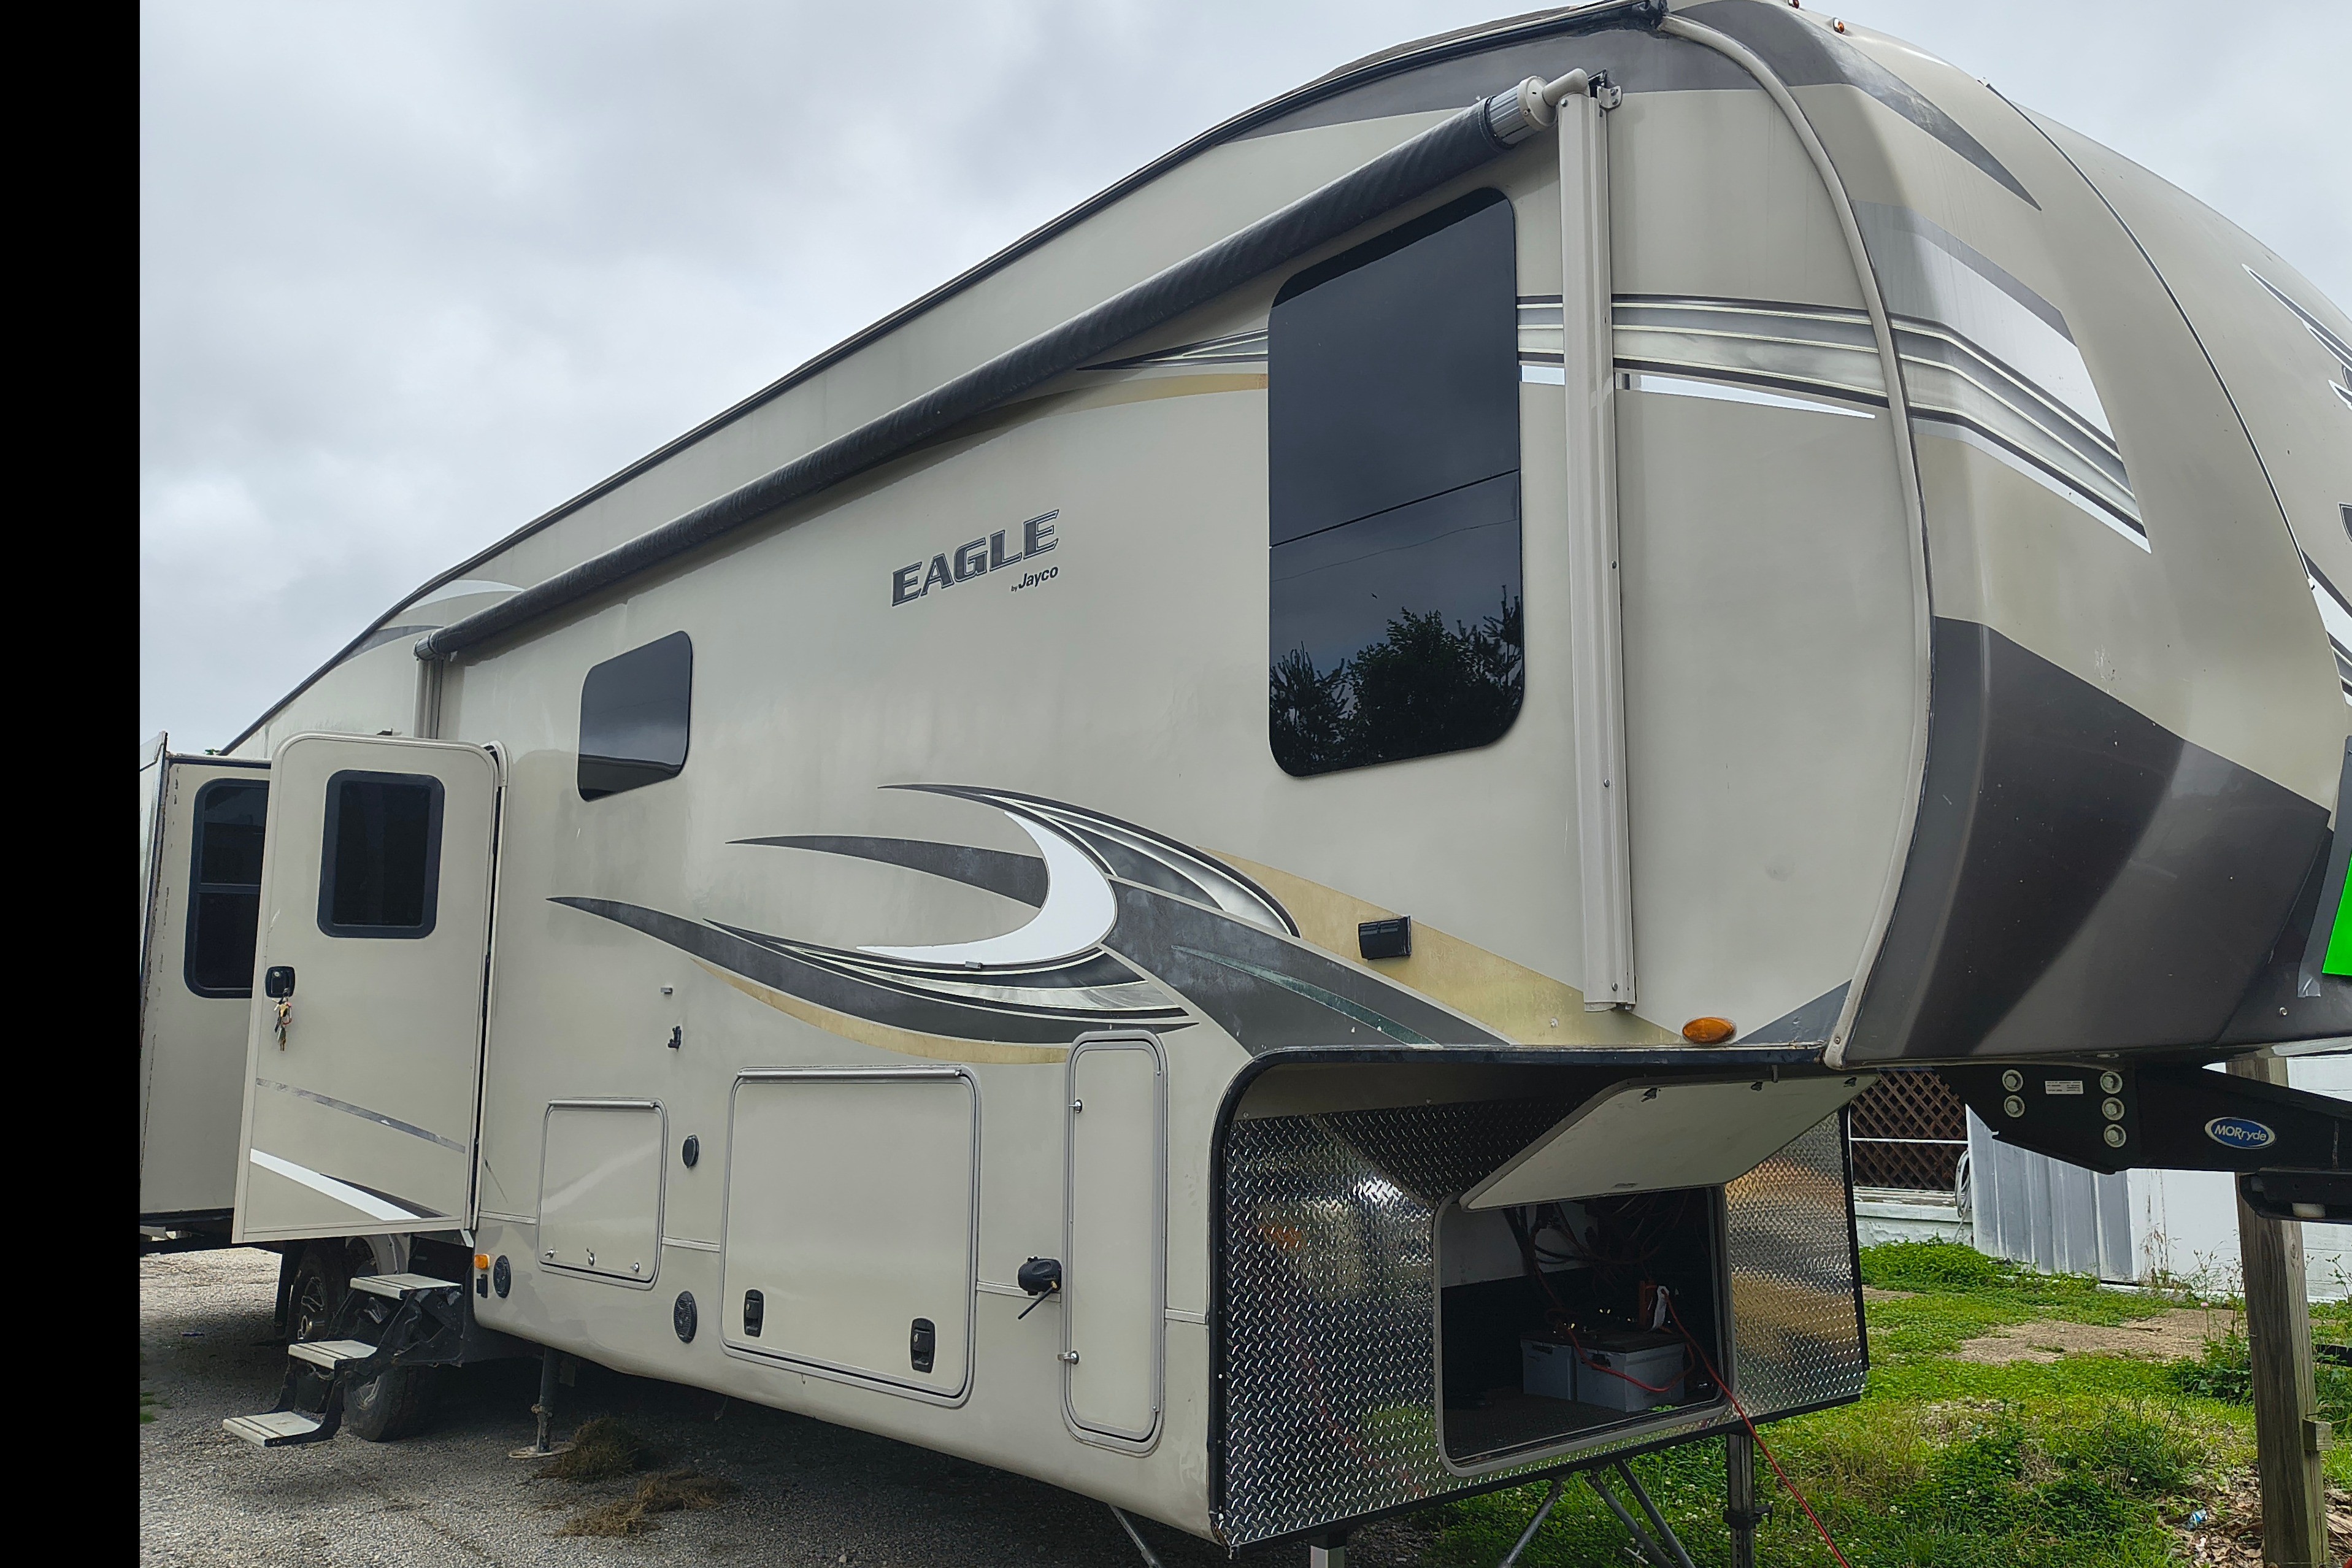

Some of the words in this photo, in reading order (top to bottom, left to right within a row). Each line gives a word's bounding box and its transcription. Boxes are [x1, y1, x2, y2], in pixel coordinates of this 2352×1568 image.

[892, 509, 1059, 607] EAGLE
[1018, 566, 1059, 589] Jayco
[2214, 1124, 2267, 1141] MORryde
